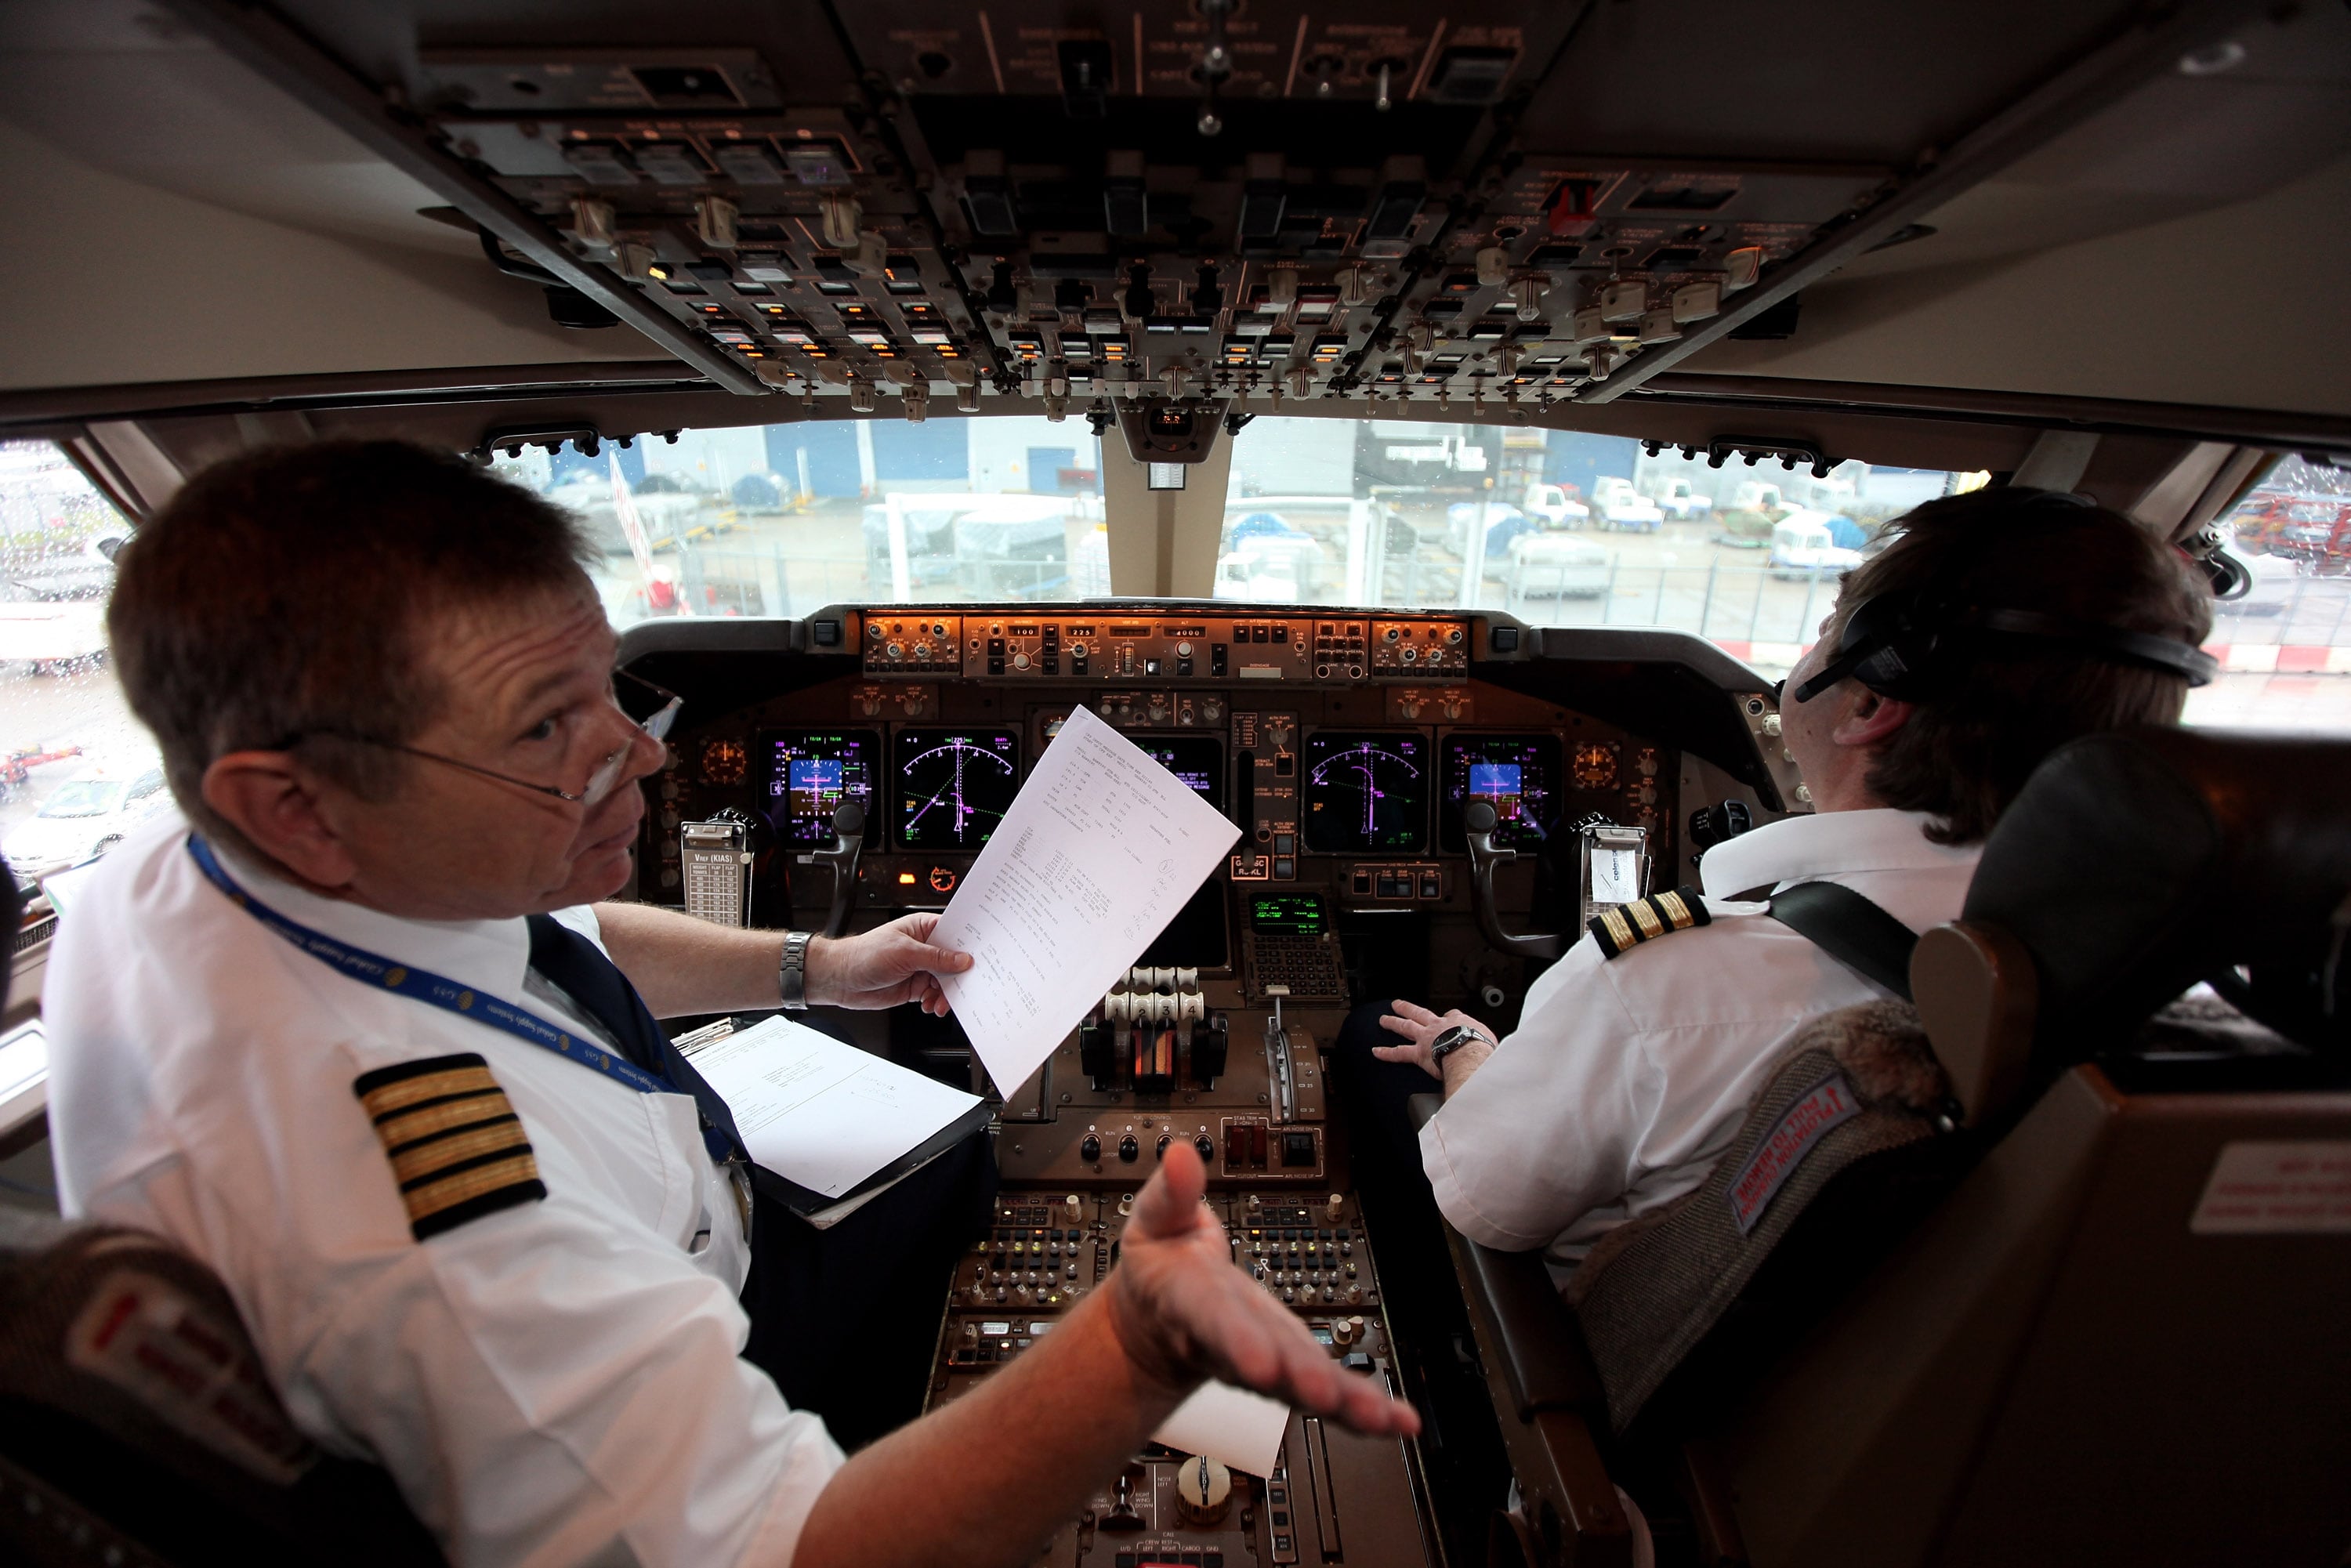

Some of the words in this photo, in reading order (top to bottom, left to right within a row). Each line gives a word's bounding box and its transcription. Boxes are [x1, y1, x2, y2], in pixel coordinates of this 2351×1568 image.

[711, 854, 733, 863] (KIAS)
[485, 1004, 516, 1023] Systems
[1163, 1006, 1170, 1015] 3
[1188, 1005, 1196, 1014] 4
[514, 1015, 538, 1032] Supply
[535, 1027, 558, 1042] Global
[583, 1049, 600, 1062] GSS
[617, 1065, 638, 1081] Systems
[635, 1074, 653, 1089] Supply
[1786, 1095, 1820, 1128] PULL
[1772, 1129, 1788, 1151] TO
[1776, 1103, 1834, 1164] FLOTATION
[1736, 1146, 1776, 1203] REMOVE
